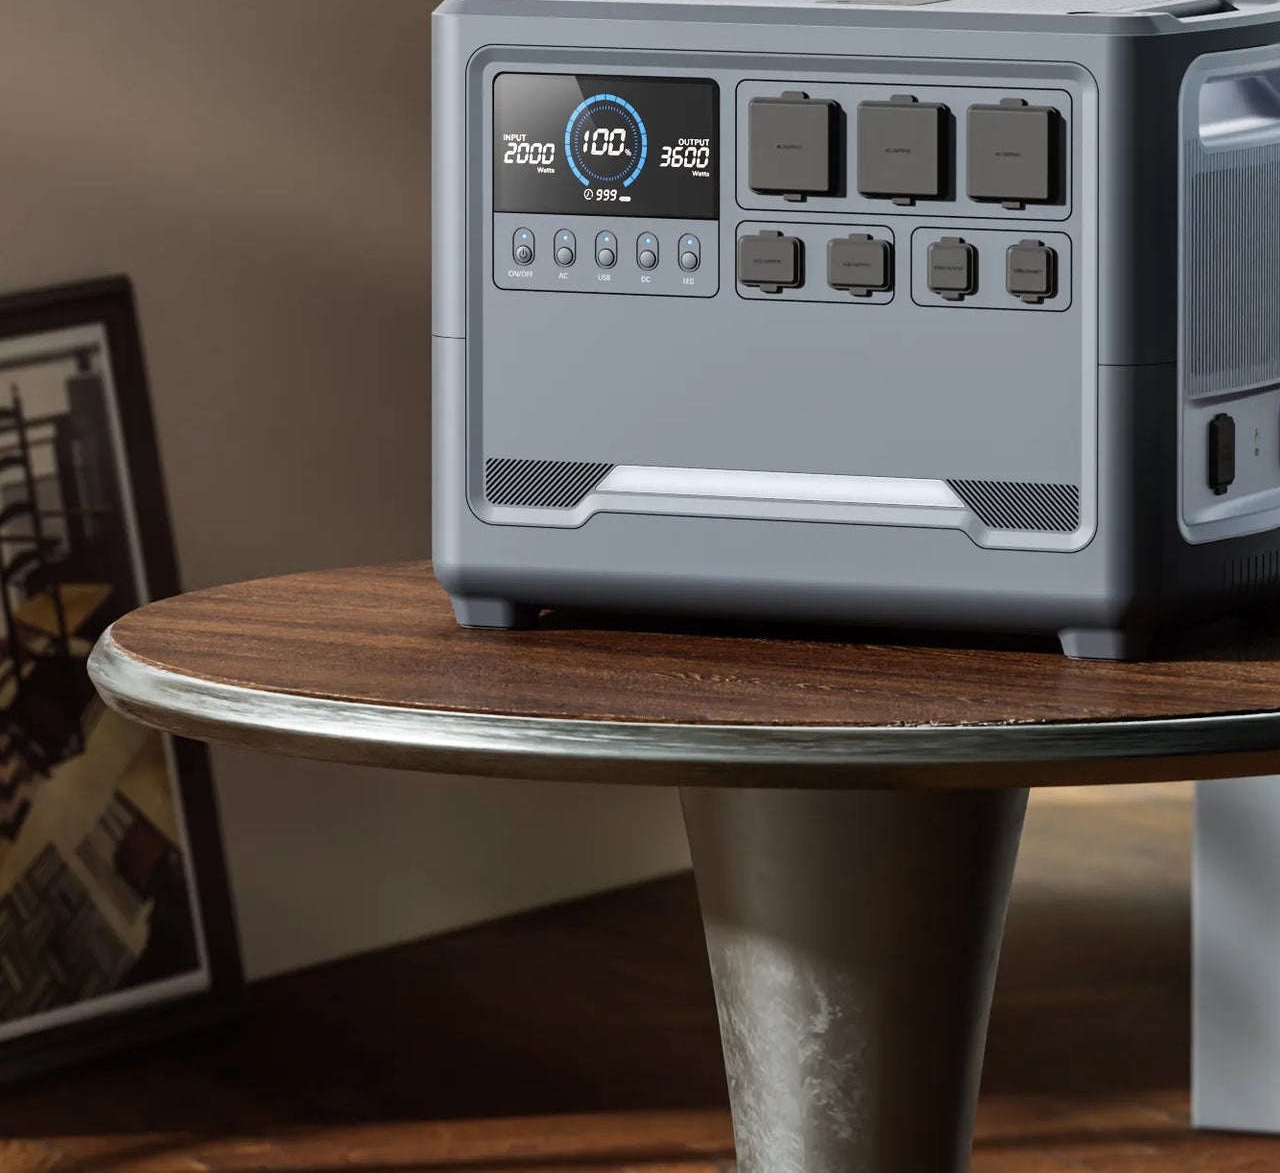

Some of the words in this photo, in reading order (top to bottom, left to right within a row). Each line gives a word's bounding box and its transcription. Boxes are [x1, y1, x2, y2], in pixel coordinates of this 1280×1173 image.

[503, 133, 527, 142] INPUT
[678, 138, 710, 147] OUTPUT
[504, 142, 556, 165] 2000
[659, 146, 710, 169] 3600
[537, 166, 556, 174] Watts
[692, 170, 710, 178] Watts
[596, 189, 618, 201] 999
[508, 269, 534, 279] ON/OFF
[558, 272, 569, 280] AC
[598, 273, 611, 282] USB
[641, 275, 652, 283] DC
[683, 277, 695, 285] LED
